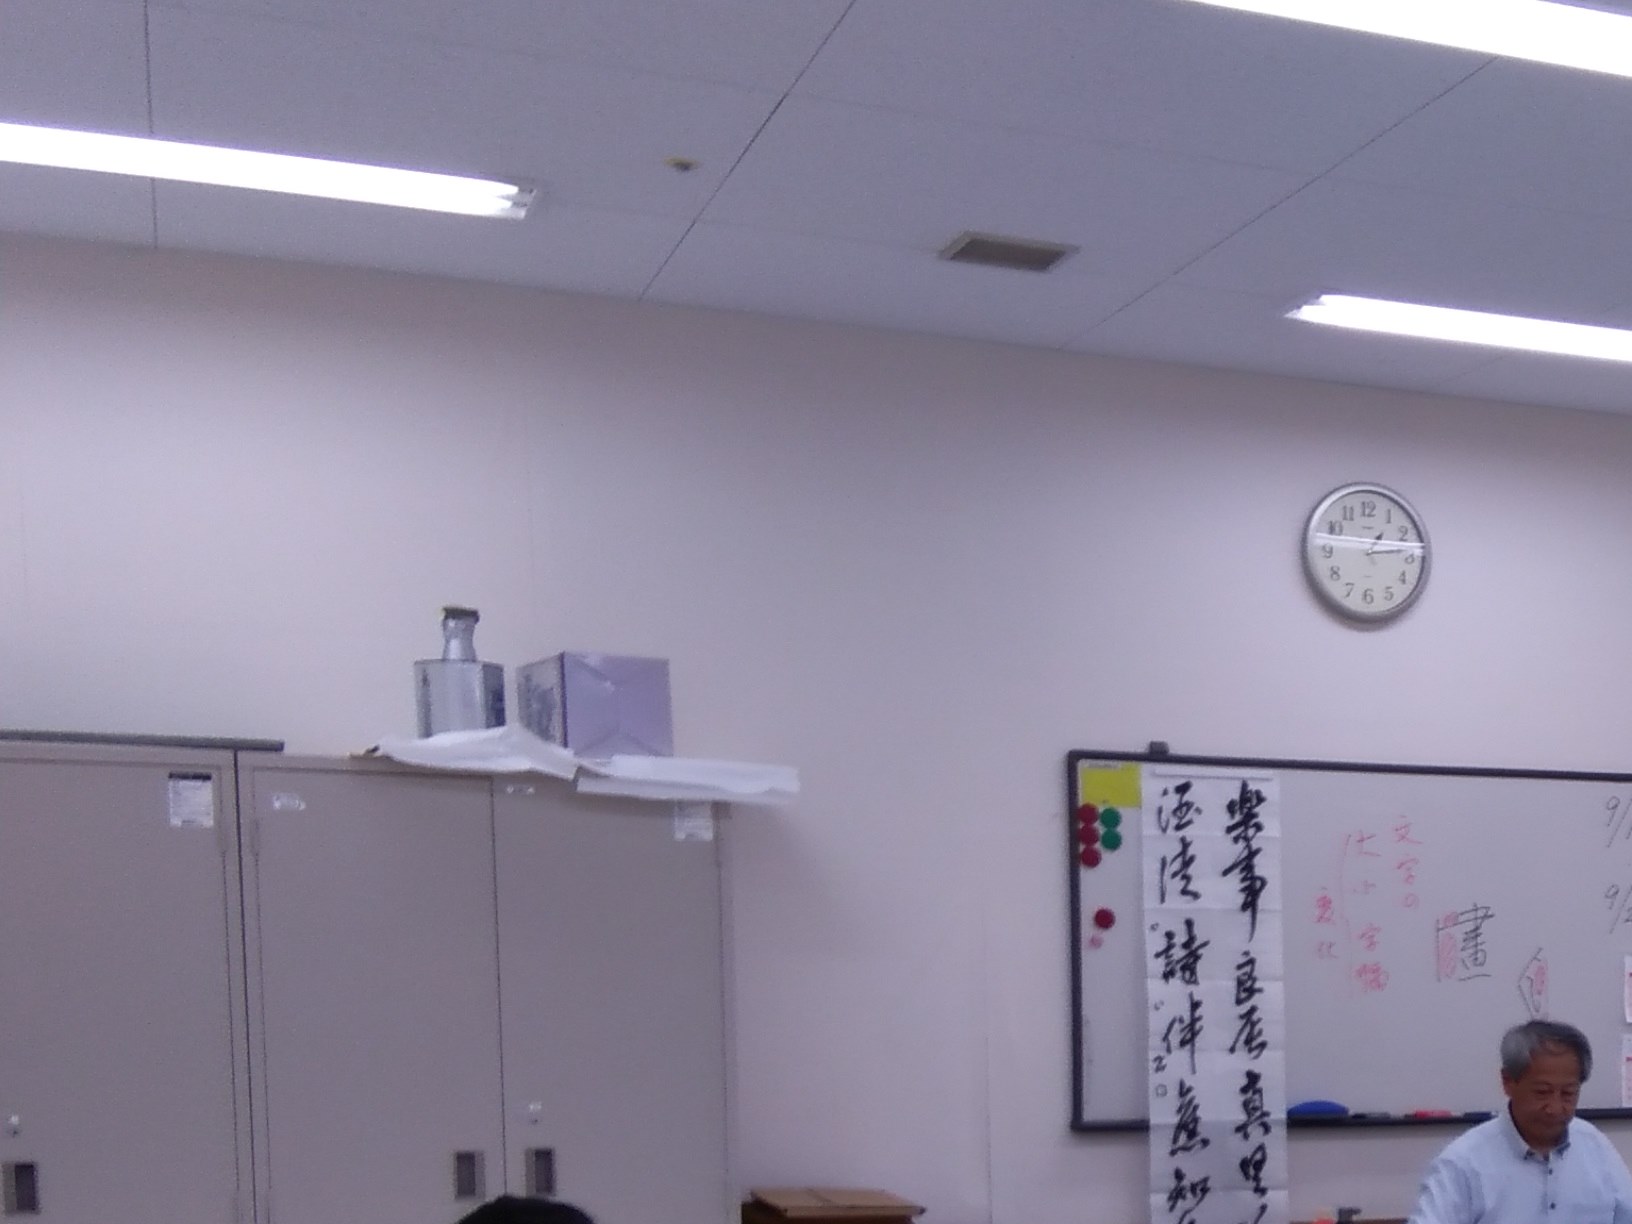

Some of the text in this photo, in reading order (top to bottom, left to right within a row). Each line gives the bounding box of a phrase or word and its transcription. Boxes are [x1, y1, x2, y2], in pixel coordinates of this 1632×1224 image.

[1342, 505, 1355, 521] 11
[1360, 501, 1376, 518] 12
[1385, 509, 1392, 524] 1
[1328, 520, 1343, 536] 10
[1399, 525, 1409, 541] 2
[1322, 543, 1333, 559] 9
[1330, 565, 1341, 581] 8
[1398, 570, 1406, 585] 4
[1344, 582, 1355, 598] 7
[1362, 588, 1374, 605] 6
[1384, 586, 1394, 601] 5
